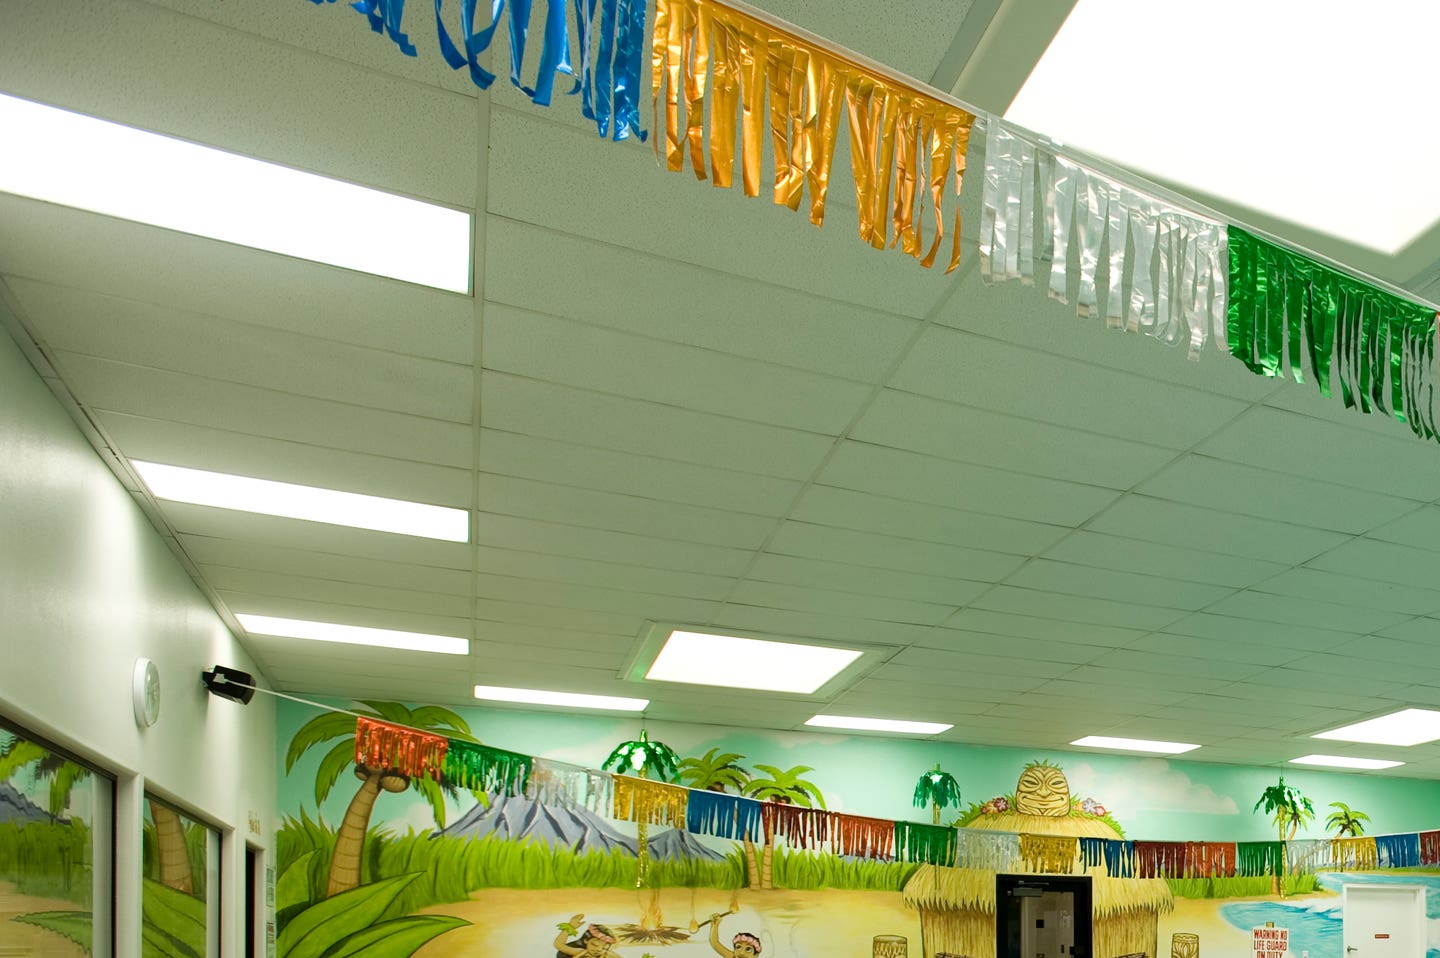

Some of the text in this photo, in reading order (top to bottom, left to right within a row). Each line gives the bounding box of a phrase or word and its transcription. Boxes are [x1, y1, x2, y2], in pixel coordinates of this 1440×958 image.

[1253, 929, 1287, 940] WARNING NO
[1253, 940, 1287, 951] LIFE GUARD
